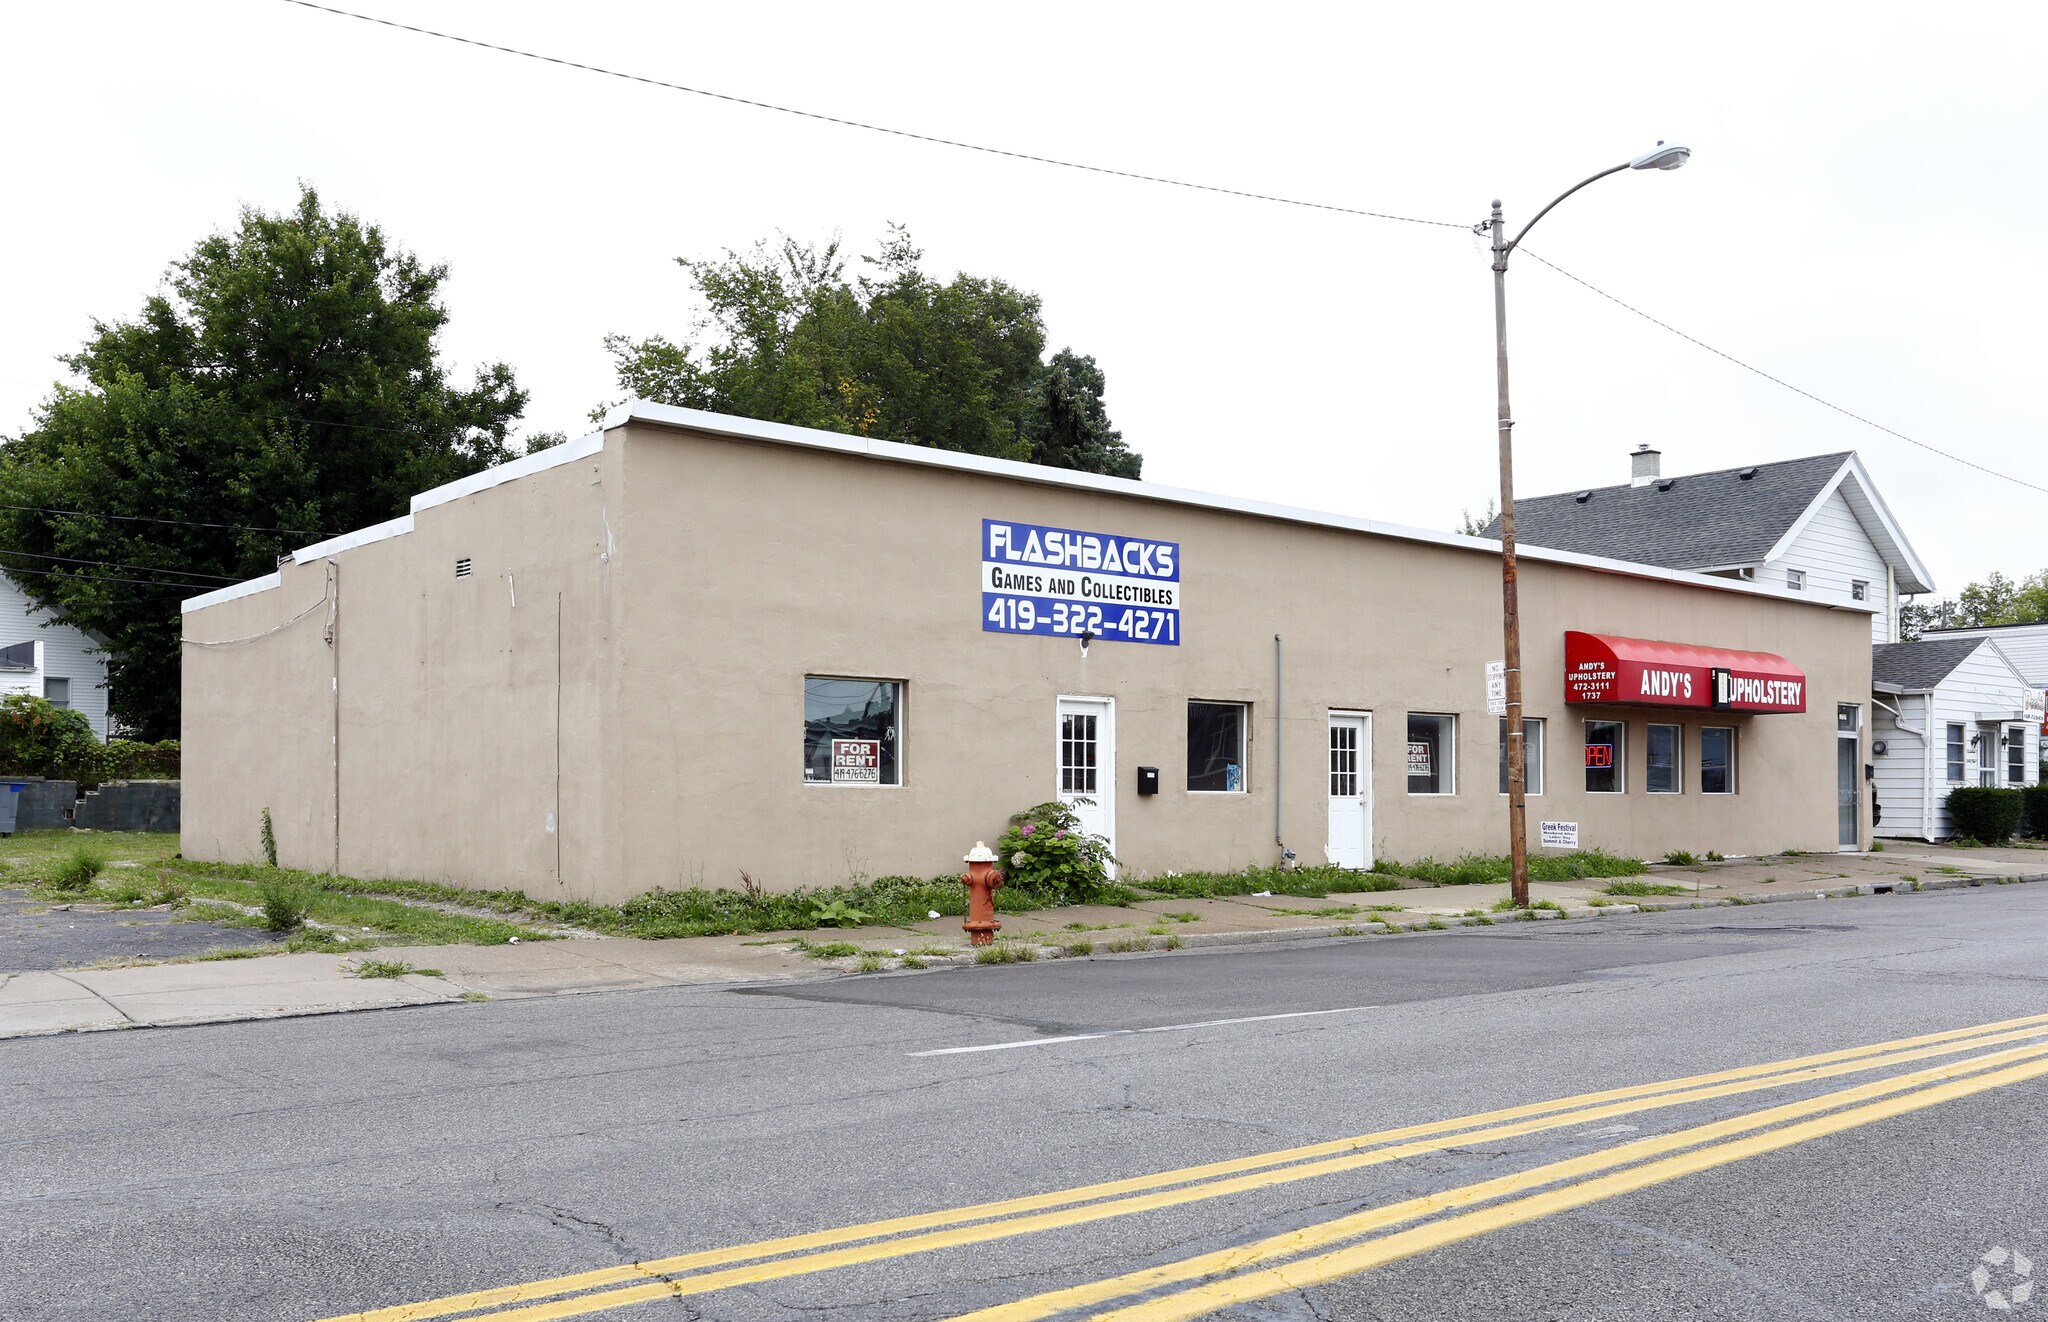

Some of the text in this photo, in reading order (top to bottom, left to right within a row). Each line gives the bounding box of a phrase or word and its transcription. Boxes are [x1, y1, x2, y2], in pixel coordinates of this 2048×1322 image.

[990, 524, 1174, 578] FLASHBACKS
[991, 566, 1173, 605] GAMES AND COLLECTIBLES
[988, 597, 1175, 641] 419-322-4271
[1578, 662, 1605, 671] ANDY'S
[1568, 670, 1616, 681] UPHOLSTERY
[1573, 681, 1610, 691] 472-3111
[1640, 669, 1692, 699] ANDY'S
[1582, 691, 1601, 700] 1737
[1730, 677, 1802, 706] UPHOLSTERY
[840, 743, 871, 755] FOR
[1407, 745, 1424, 754] FOR
[835, 755, 876, 766] RENT
[1584, 746, 1611, 766] OPEN
[1542, 822, 1576, 832] Greek Festival
